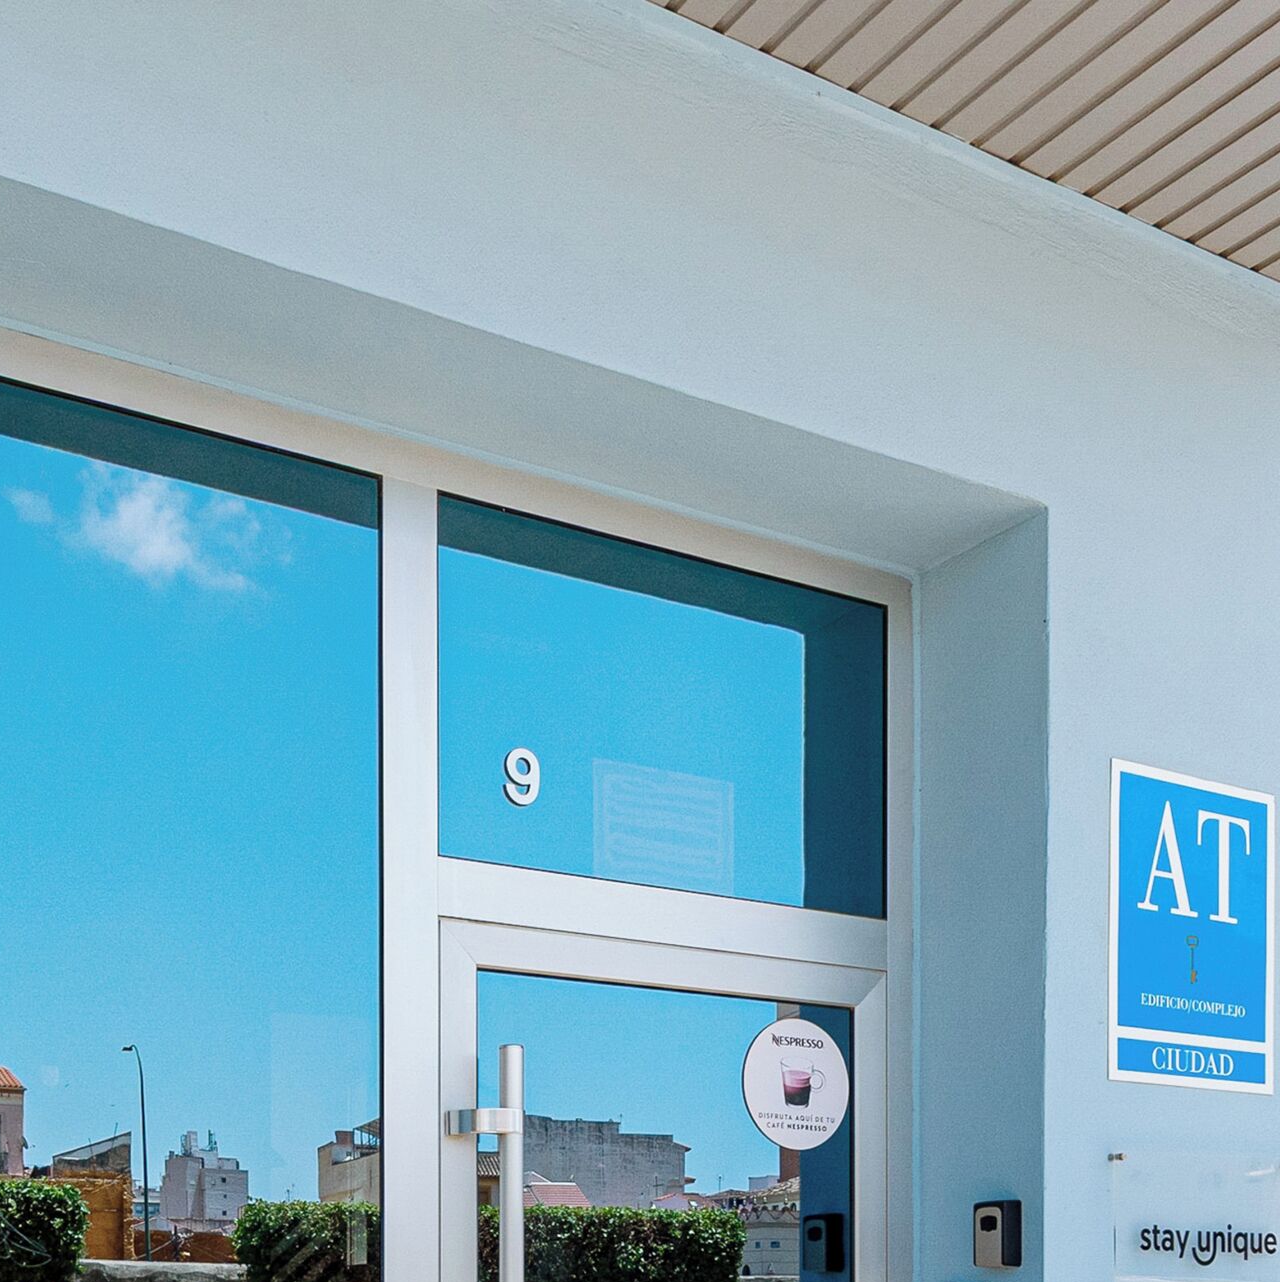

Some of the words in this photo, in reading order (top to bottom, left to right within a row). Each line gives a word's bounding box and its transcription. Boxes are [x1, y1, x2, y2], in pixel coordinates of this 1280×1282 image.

[503, 746, 541, 808] 9
[1137, 799, 1251, 925] AT
[1140, 991, 1246, 1019] EDIFICIO/COMPLEJO
[771, 1032, 824, 1050] NESPRESSO
[1151, 1045, 1235, 1077] CIUDAD
[758, 1111, 793, 1121] DISFRUTA
[795, 1113, 813, 1123] AQUÍ
[815, 1115, 824, 1123] DE
[766, 1121, 785, 1130] CAFÉ
[787, 1124, 828, 1133] NESPRESSO
[1139, 1224, 1190, 1259] stay
[1192, 1223, 1278, 1267] unique
